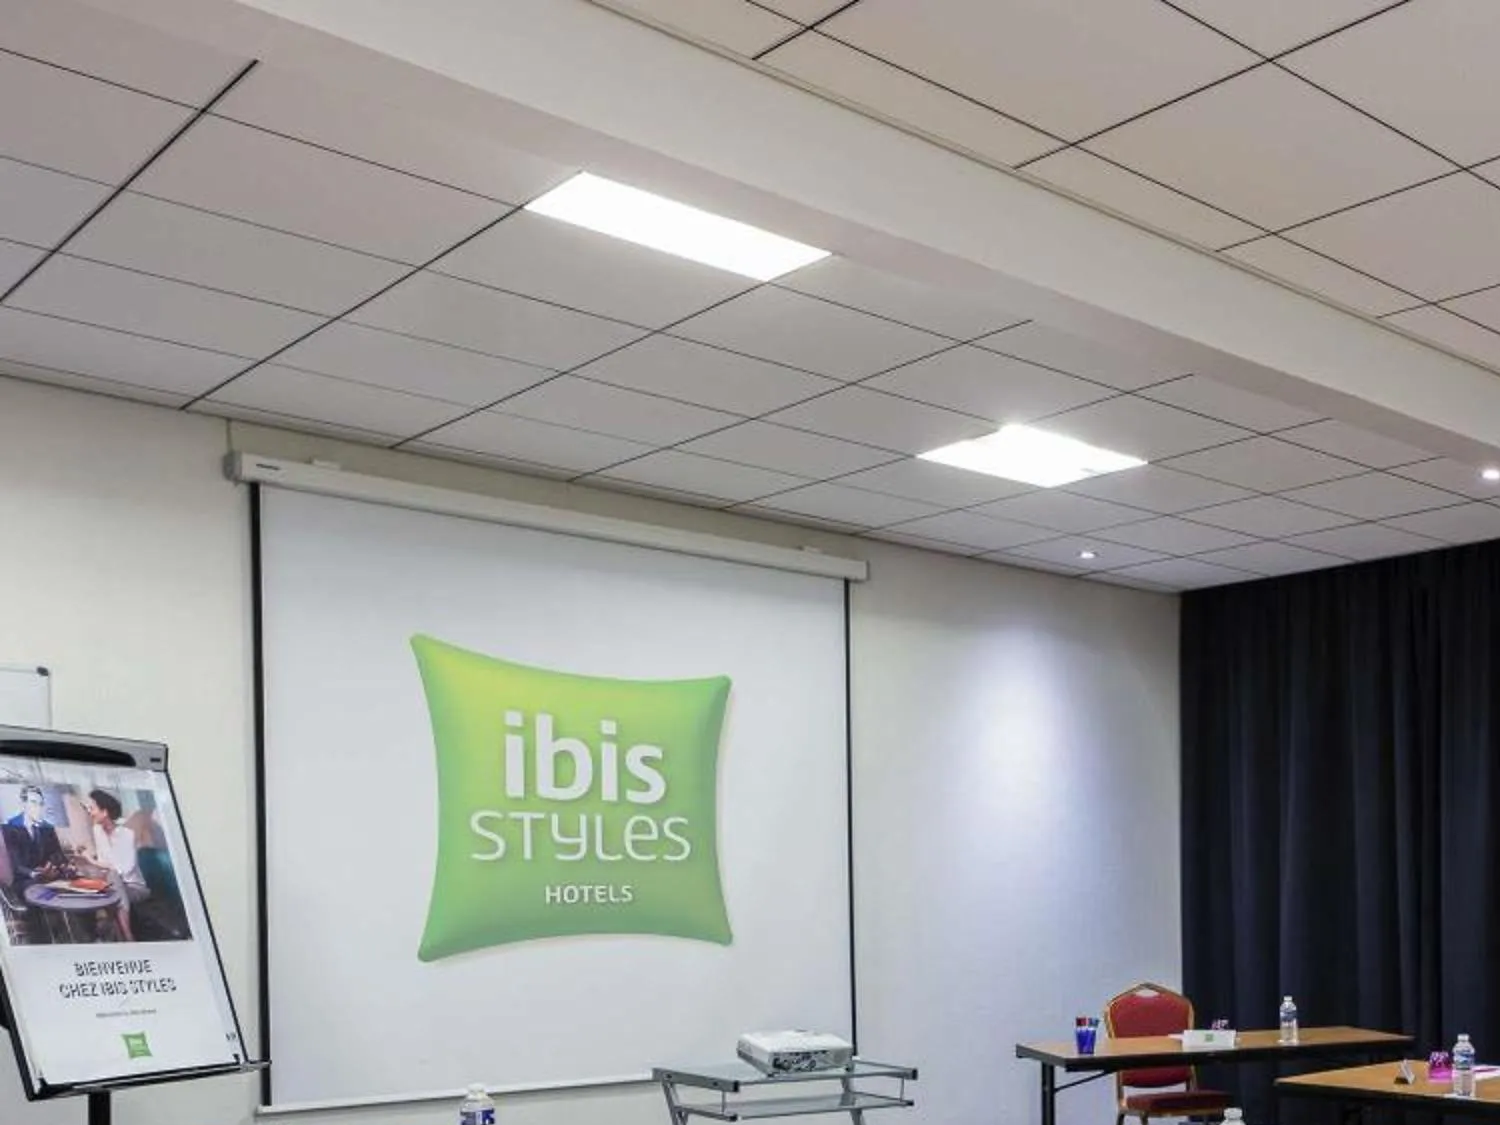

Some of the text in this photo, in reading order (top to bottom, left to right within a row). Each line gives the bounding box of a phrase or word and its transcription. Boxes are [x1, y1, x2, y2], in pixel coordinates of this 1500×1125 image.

[504, 709, 668, 805] ibis
[545, 884, 635, 905] HOTELS
[73, 958, 153, 977] BIENVENUE
[59, 977, 177, 999] CHEZ IBIS STYLES
